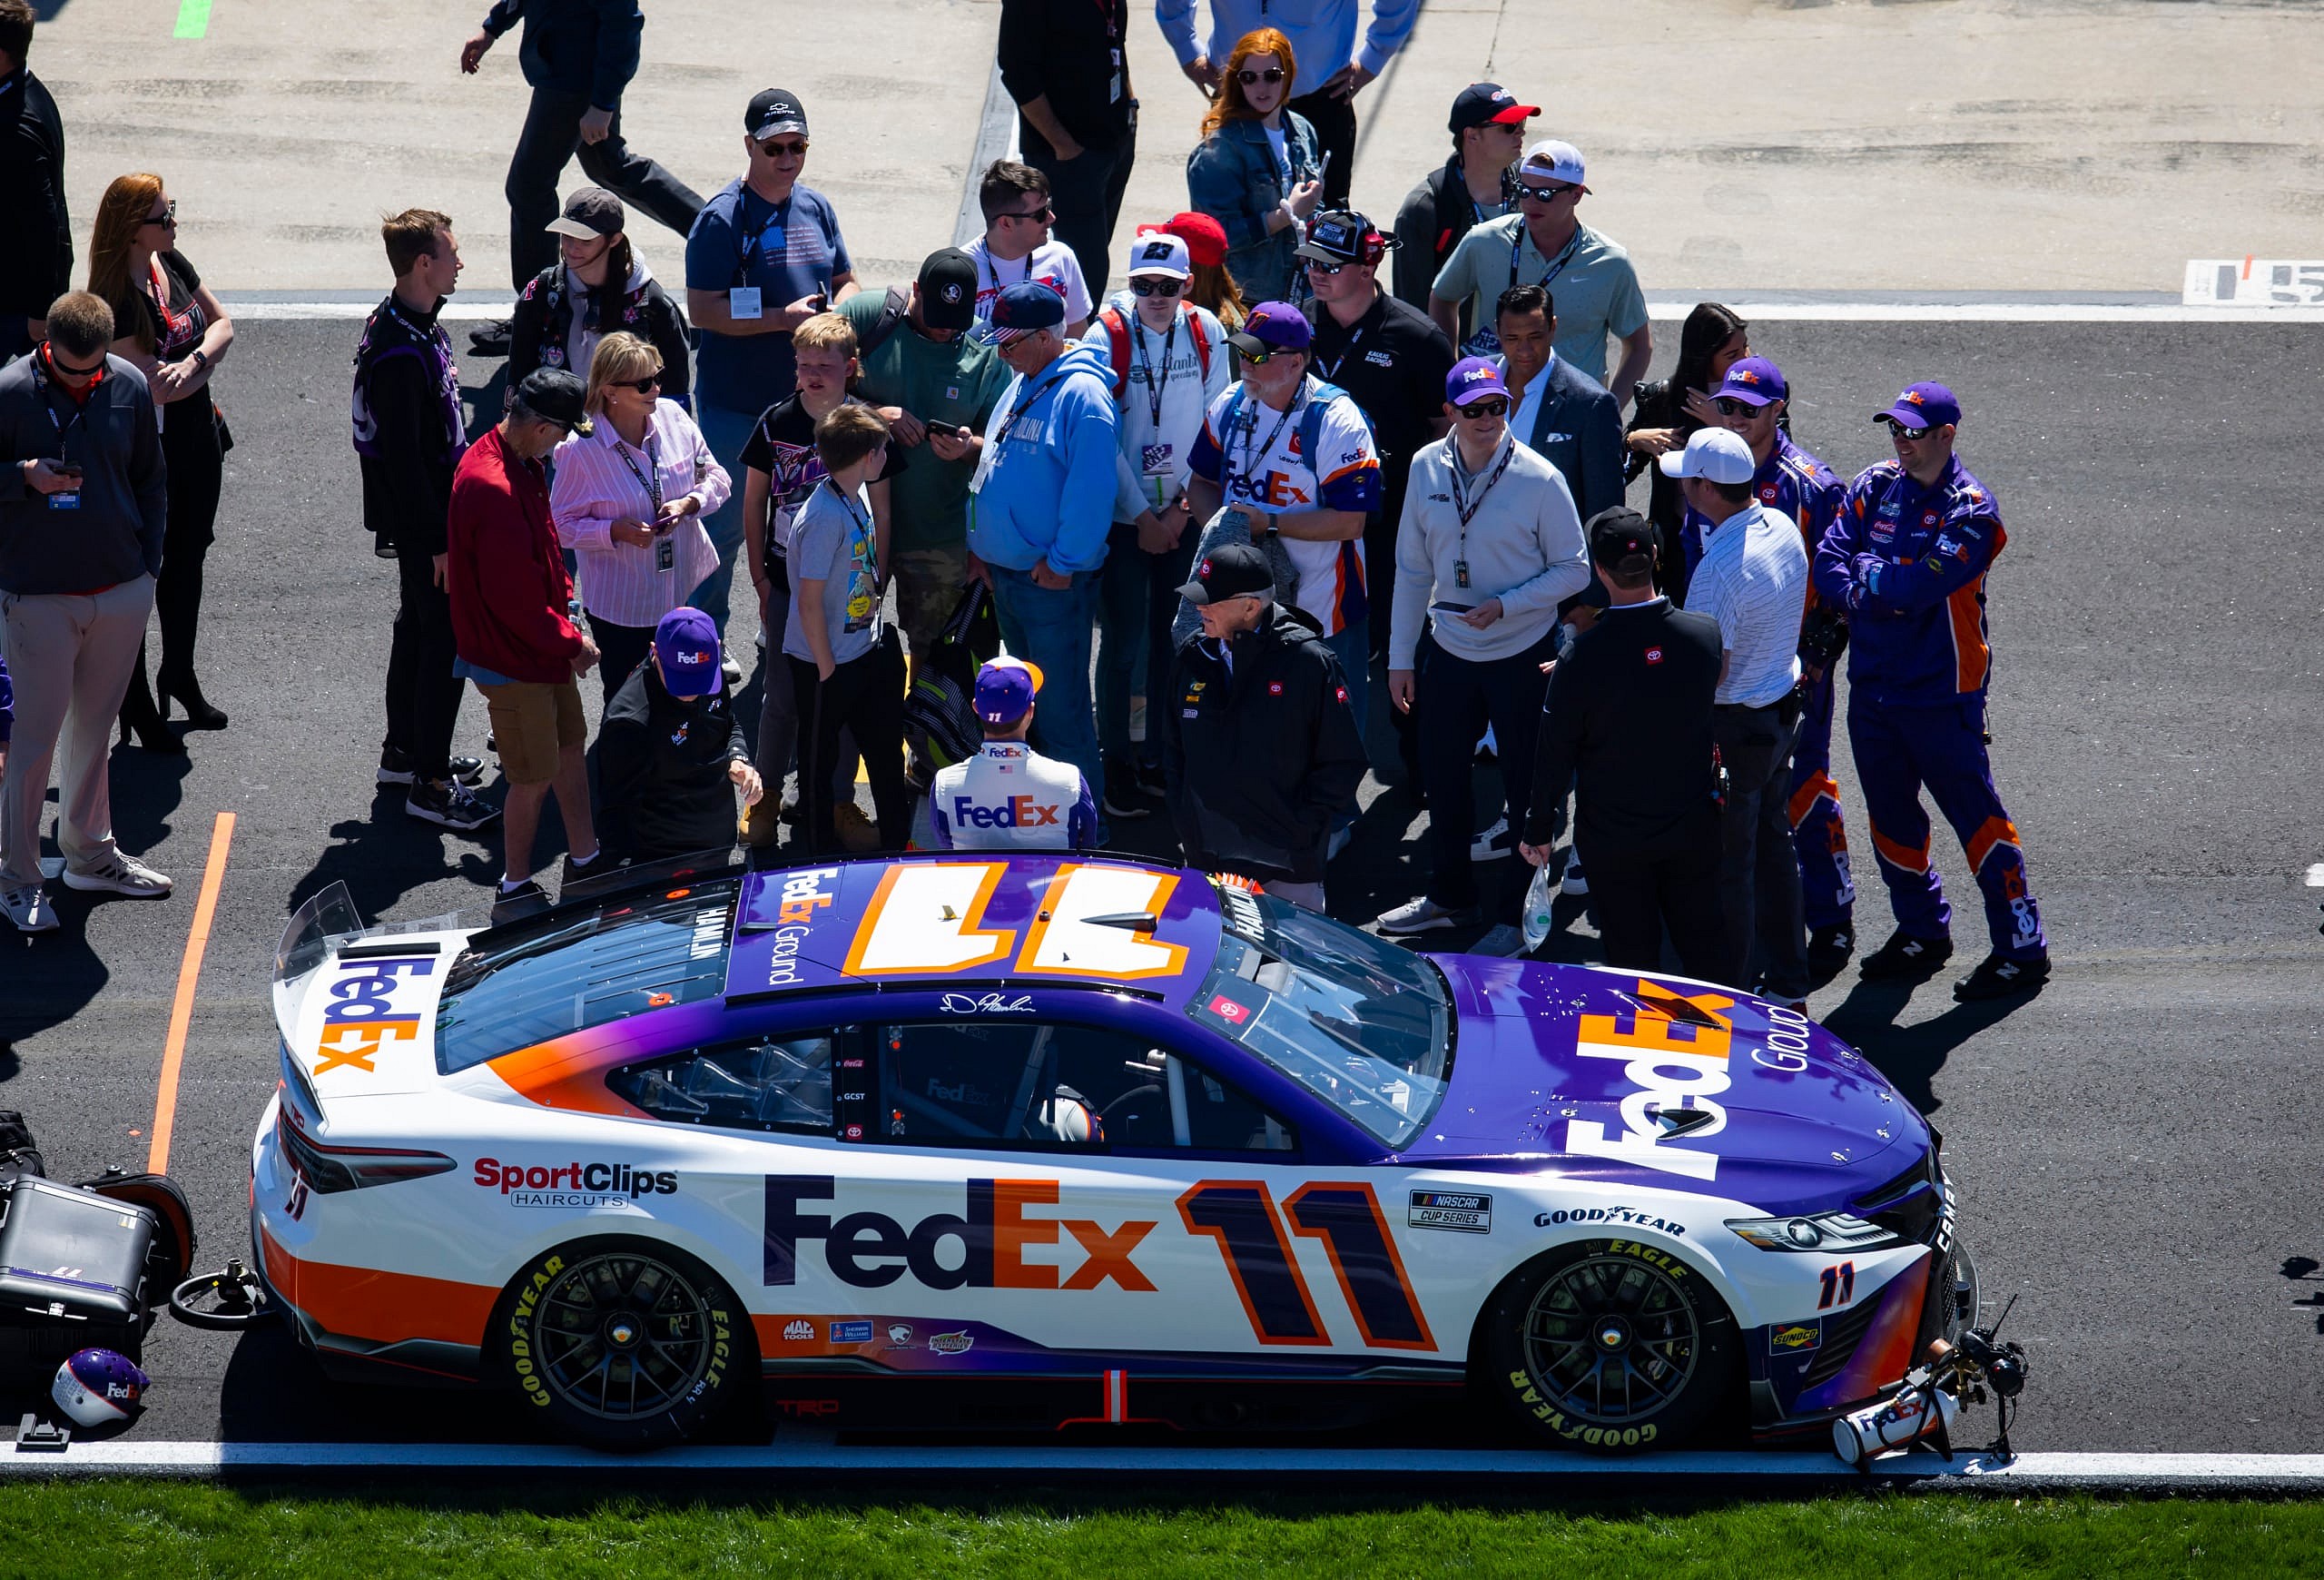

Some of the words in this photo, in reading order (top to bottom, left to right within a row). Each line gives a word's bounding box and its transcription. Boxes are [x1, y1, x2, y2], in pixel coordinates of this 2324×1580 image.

[1463, 367, 1497, 383] FedEx
[1728, 370, 1759, 385] FedEx
[1226, 459, 1311, 507] FedEx
[677, 651, 710, 665] FedEx
[988, 712, 1002, 723] 11
[989, 747, 1022, 757] FedEx
[954, 795, 1059, 829] FedEx
[777, 867, 839, 924] FedEx
[690, 906, 728, 960] HAMLIN
[840, 862, 1190, 982] 11
[769, 925, 815, 985] Ground
[1832, 933, 1848, 949] N
[1903, 941, 1924, 957] N
[1996, 962, 2020, 981] N
[313, 958, 436, 1077] FedEx
[1565, 977, 1735, 1181] FedEx
[1751, 1000, 1810, 1072] Ground
[843, 1092, 865, 1101] GCST
[474, 1157, 679, 1200] SportClips
[516, 1193, 624, 1207] HAIRCUTS
[1435, 1195, 1480, 1209] NASCAR
[1420, 1210, 1443, 1221] CUP
[1443, 1211, 1480, 1225] SERIES
[1533, 1206, 1686, 1238] GOODYEAR
[763, 1174, 1159, 1292] FedEx
[1174, 1179, 1440, 1353] 11
[1608, 1239, 1689, 1280] EAGLE
[1817, 1259, 1856, 1311] 11
[509, 1255, 566, 1407] GOODYEAR
[784, 1319, 814, 1335] MAC
[1775, 1329, 1817, 1345] SUNOCO
[704, 1308, 731, 1389] EAGLE
[776, 1398, 840, 1417] TRD
[1510, 1368, 1658, 1447] GOODYEAR
